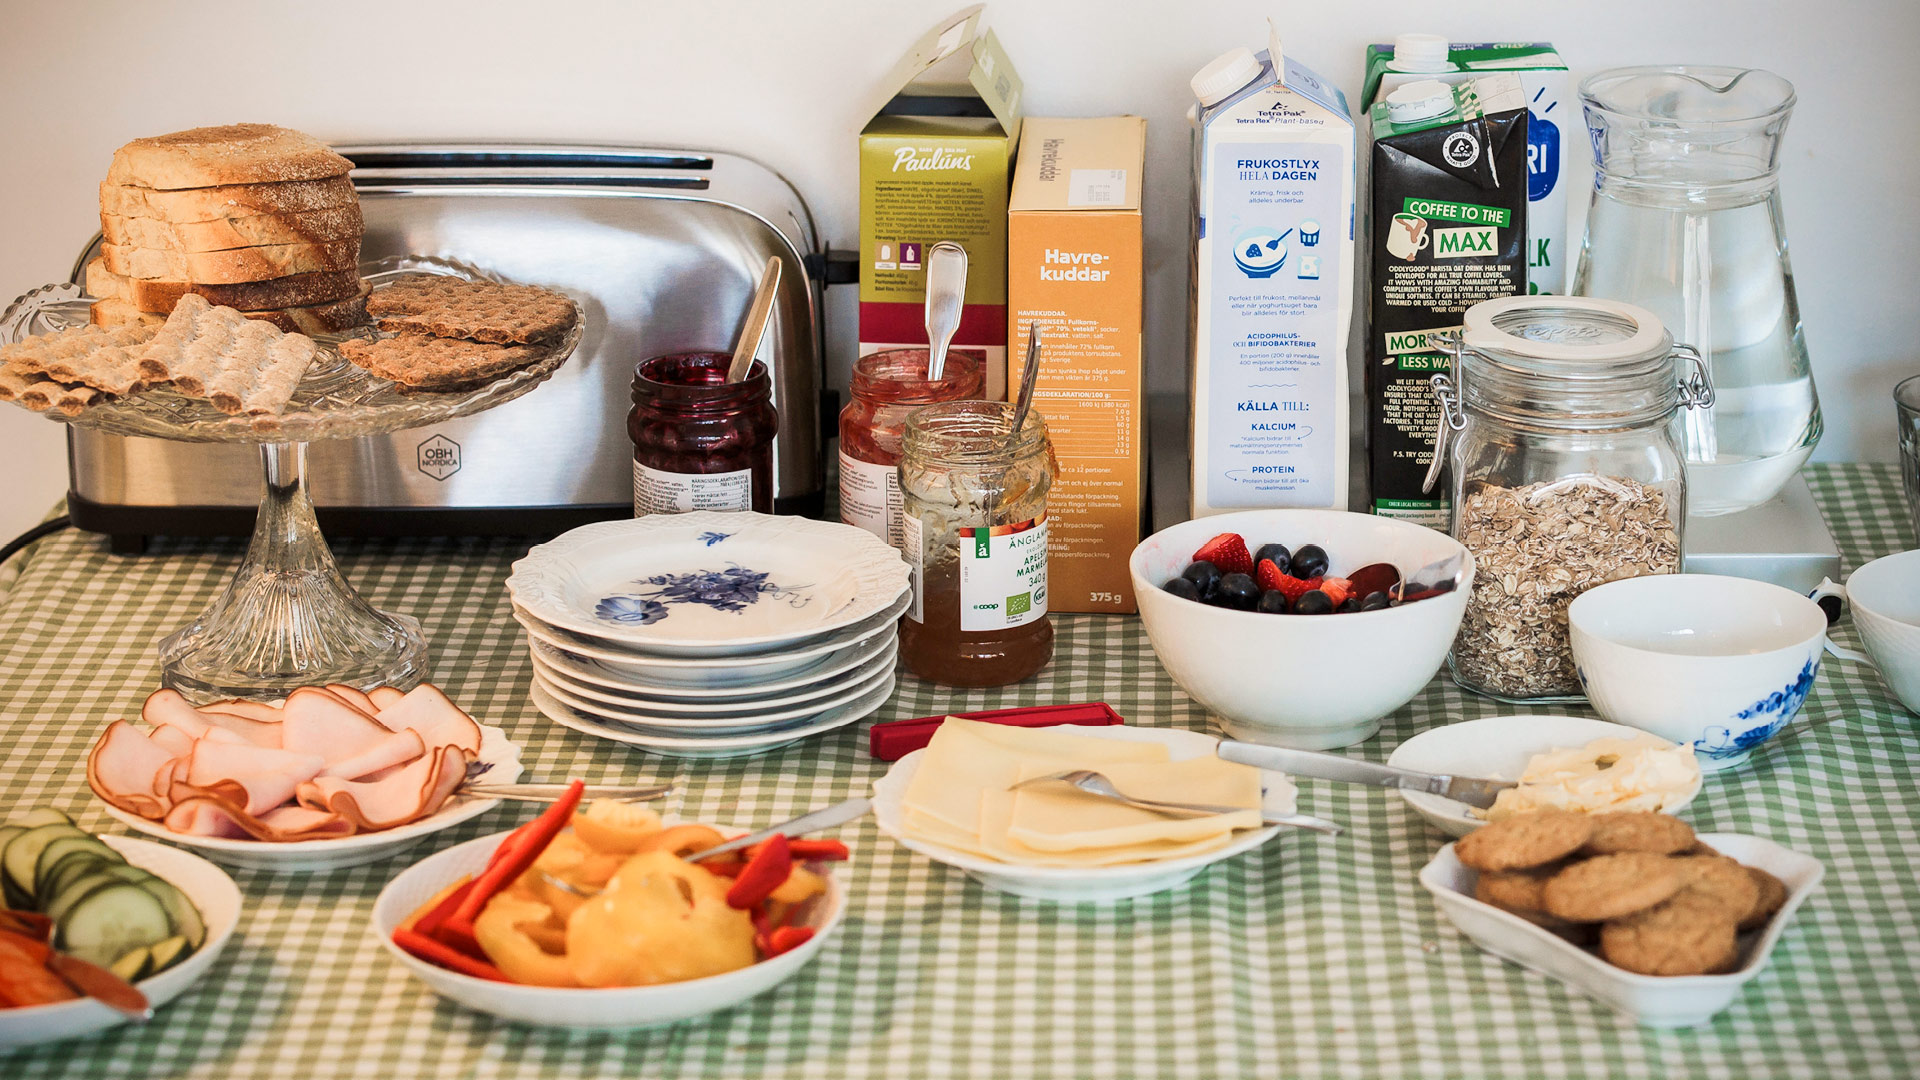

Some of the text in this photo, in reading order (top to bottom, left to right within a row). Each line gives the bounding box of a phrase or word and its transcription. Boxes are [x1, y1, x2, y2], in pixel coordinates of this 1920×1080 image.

[1274, 117, 1324, 125] Plant-based
[1449, 133, 1473, 141] PROTECTS
[1237, 159, 1320, 169] FRUKOSTLYX
[1239, 171, 1317, 181] HELA DAGEN
[1409, 201, 1504, 224] COFFEE TO THE
[1439, 231, 1492, 254] MAX
[1045, 249, 1110, 265] Havre-
[1040, 266, 1110, 282] kuddar
[1248, 340, 1316, 348] BIFIDOBAKTERIER
[1402, 357, 1428, 368] LESS
[1237, 400, 1310, 412] KÄLLA TILL:
[1251, 423, 1296, 431] KALCIUM
[425, 448, 453, 459] OBH
[1252, 466, 1295, 474] PROTEIN
[1029, 573, 1042, 587] 340
[1090, 592, 1122, 604] 375 g
